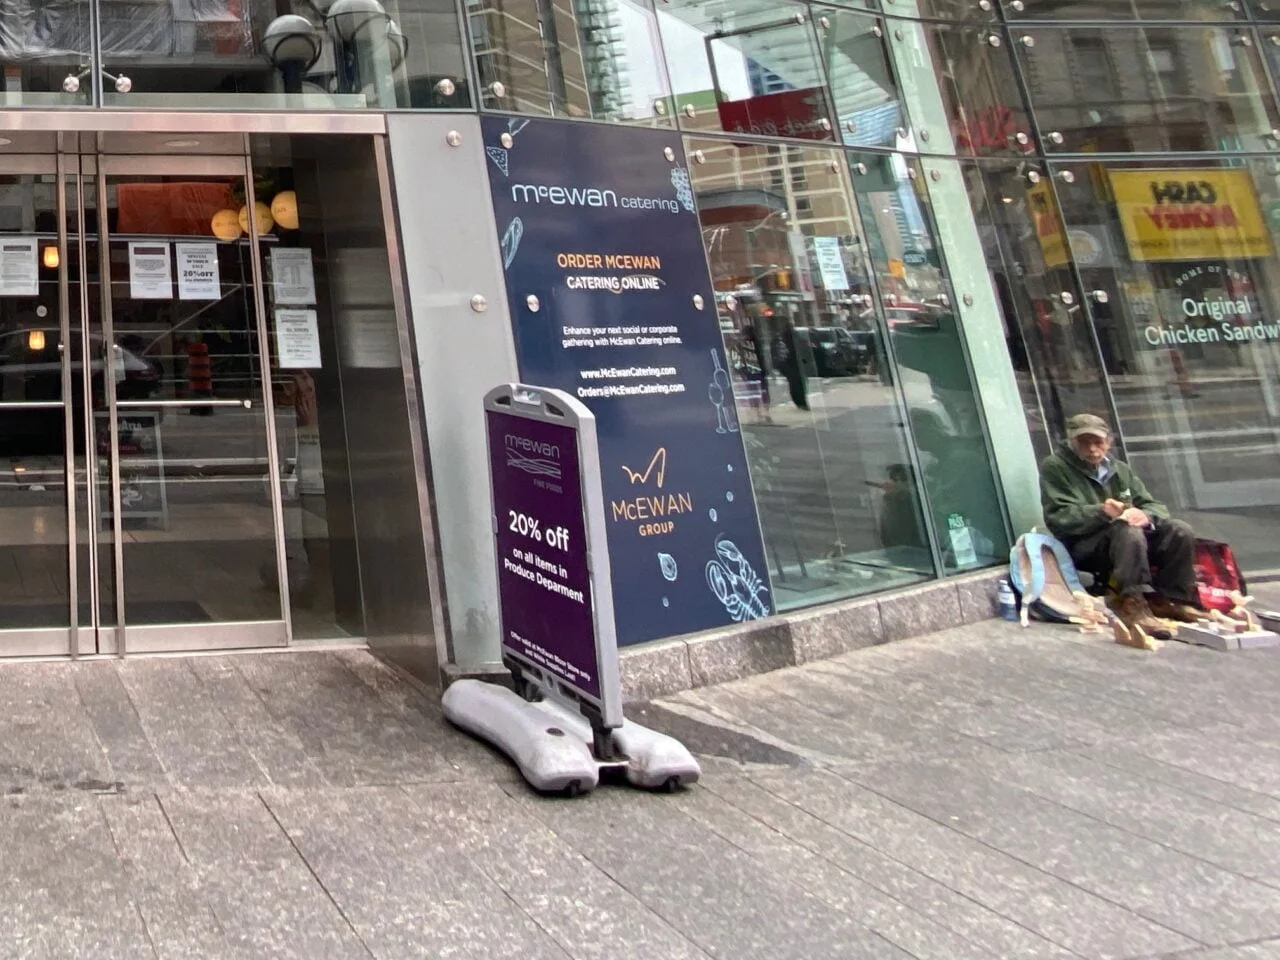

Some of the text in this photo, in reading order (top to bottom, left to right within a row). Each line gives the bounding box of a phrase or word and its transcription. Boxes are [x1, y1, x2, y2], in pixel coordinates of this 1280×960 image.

[512, 183, 679, 213] mcewan catering
[557, 253, 661, 269] ORDER MCEWAN
[567, 276, 660, 290] CATERING ONLINE
[1182, 296, 1251, 320] Original
[563, 326, 591, 335] Enhance
[592, 327, 606, 336] your
[607, 326, 621, 334] next
[623, 325, 640, 334] social
[649, 325, 678, 336] corporate
[1145, 325, 1220, 345] Chicken
[562, 337, 593, 348] gathering
[594, 337, 608, 345] with
[636, 336, 662, 346] Catering
[581, 366, 676, 379] www.McEwanCatering.com
[508, 510, 569, 552] 20% off
[639, 521, 675, 536] GROUP
[513, 548, 567, 578] on all items in
[505, 559, 584, 603] Produce Deparment
